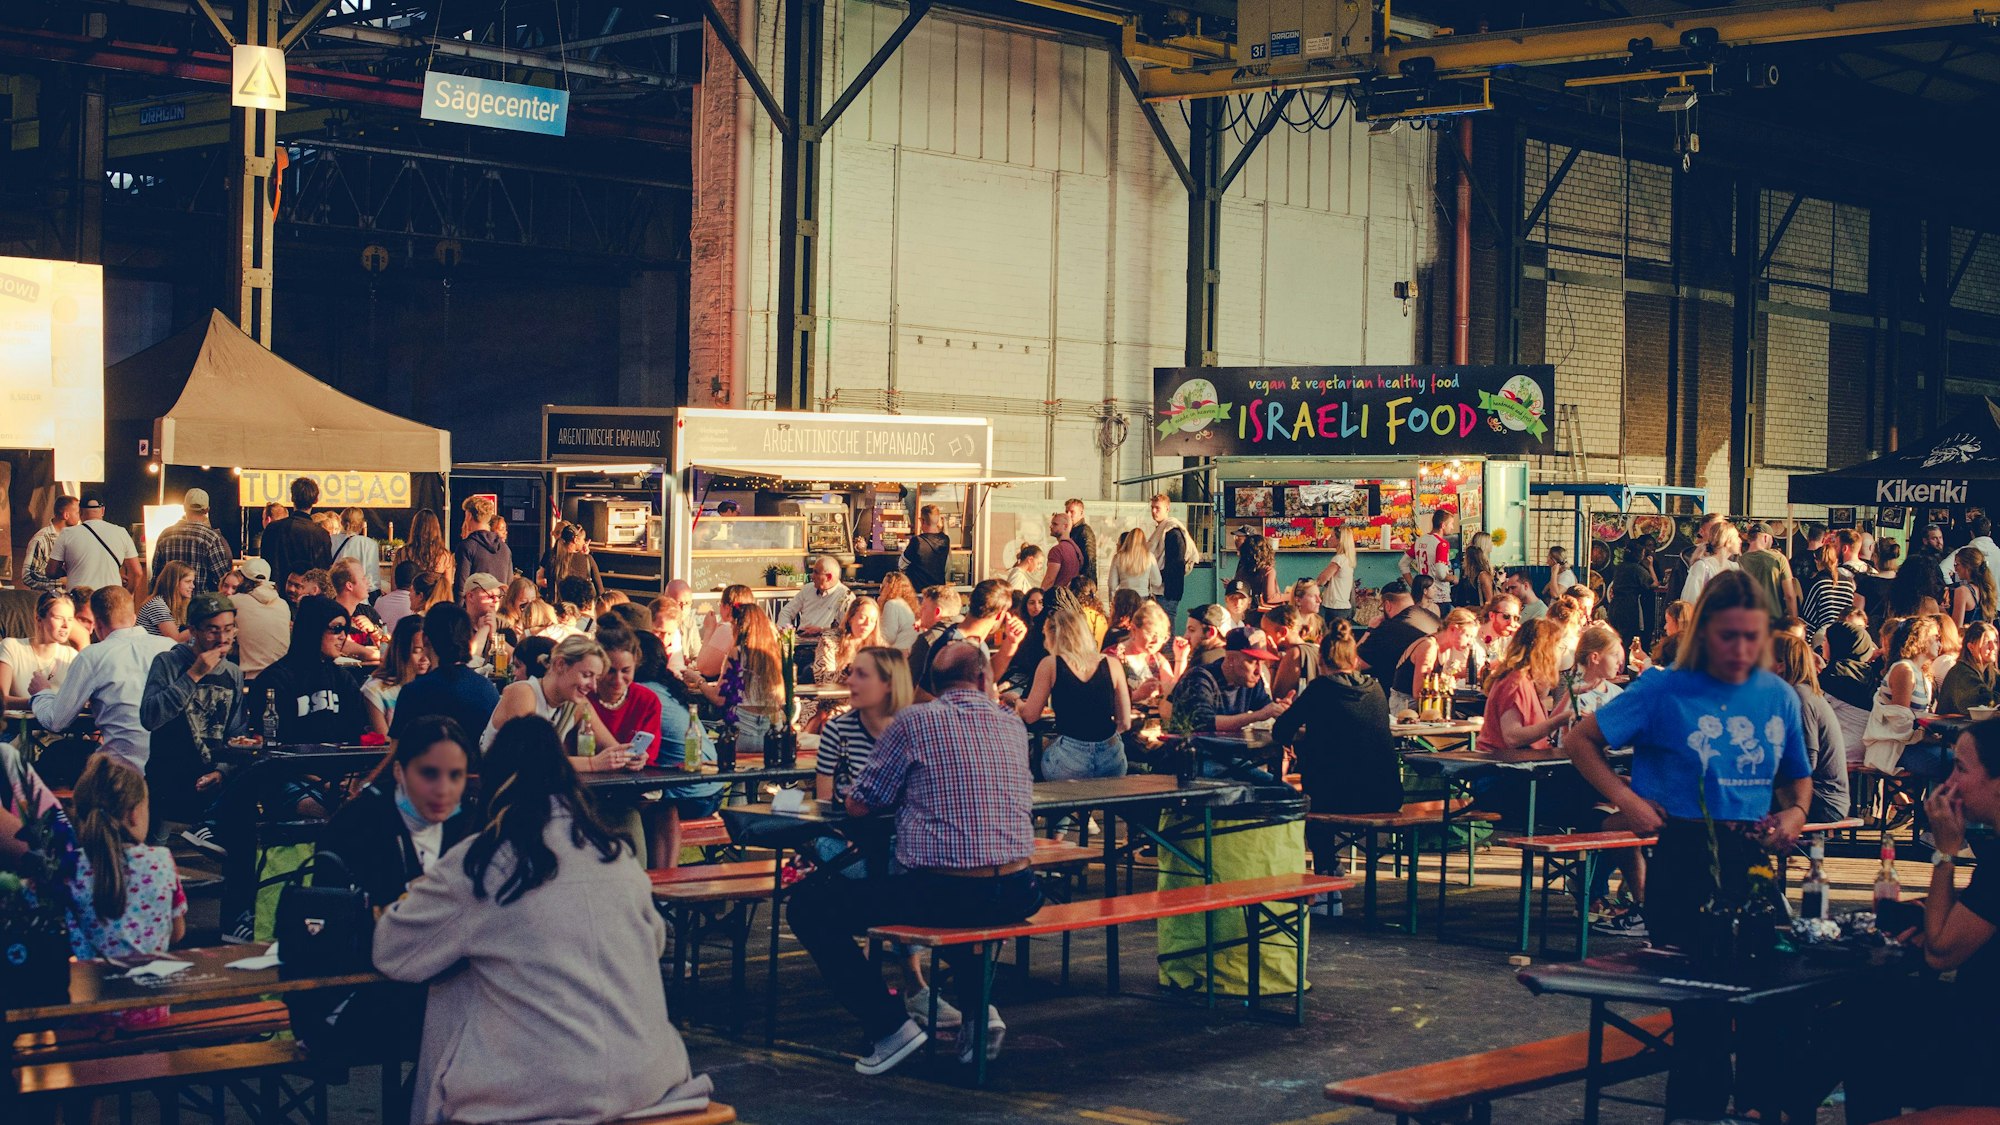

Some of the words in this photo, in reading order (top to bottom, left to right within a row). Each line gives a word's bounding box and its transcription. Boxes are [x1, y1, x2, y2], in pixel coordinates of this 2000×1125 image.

[1271, 31, 1300, 41] DRAGON
[1252, 45, 1263, 58] 3F
[434, 80, 561, 123] Sägecenter
[141, 104, 185, 124] DRAGON
[1249, 379, 1287, 396] vegan
[1291, 375, 1301, 390] &
[1305, 374, 1373, 396] vegetarian
[1378, 373, 1426, 394] healthy
[1431, 373, 1460, 394] food
[1492, 400, 1515, 411] handmade
[1238, 400, 1369, 443] ISRAELI
[1385, 396, 1478, 445] FOOD
[558, 428, 613, 446] ARGENTINISCHE
[615, 429, 661, 447] EMPANADAS
[763, 427, 860, 455] ARGENTINISCHE
[866, 431, 935, 456] EMPANADAS
[1876, 479, 1969, 504] Kikeriki
[1415, 549, 1429, 576] 13
